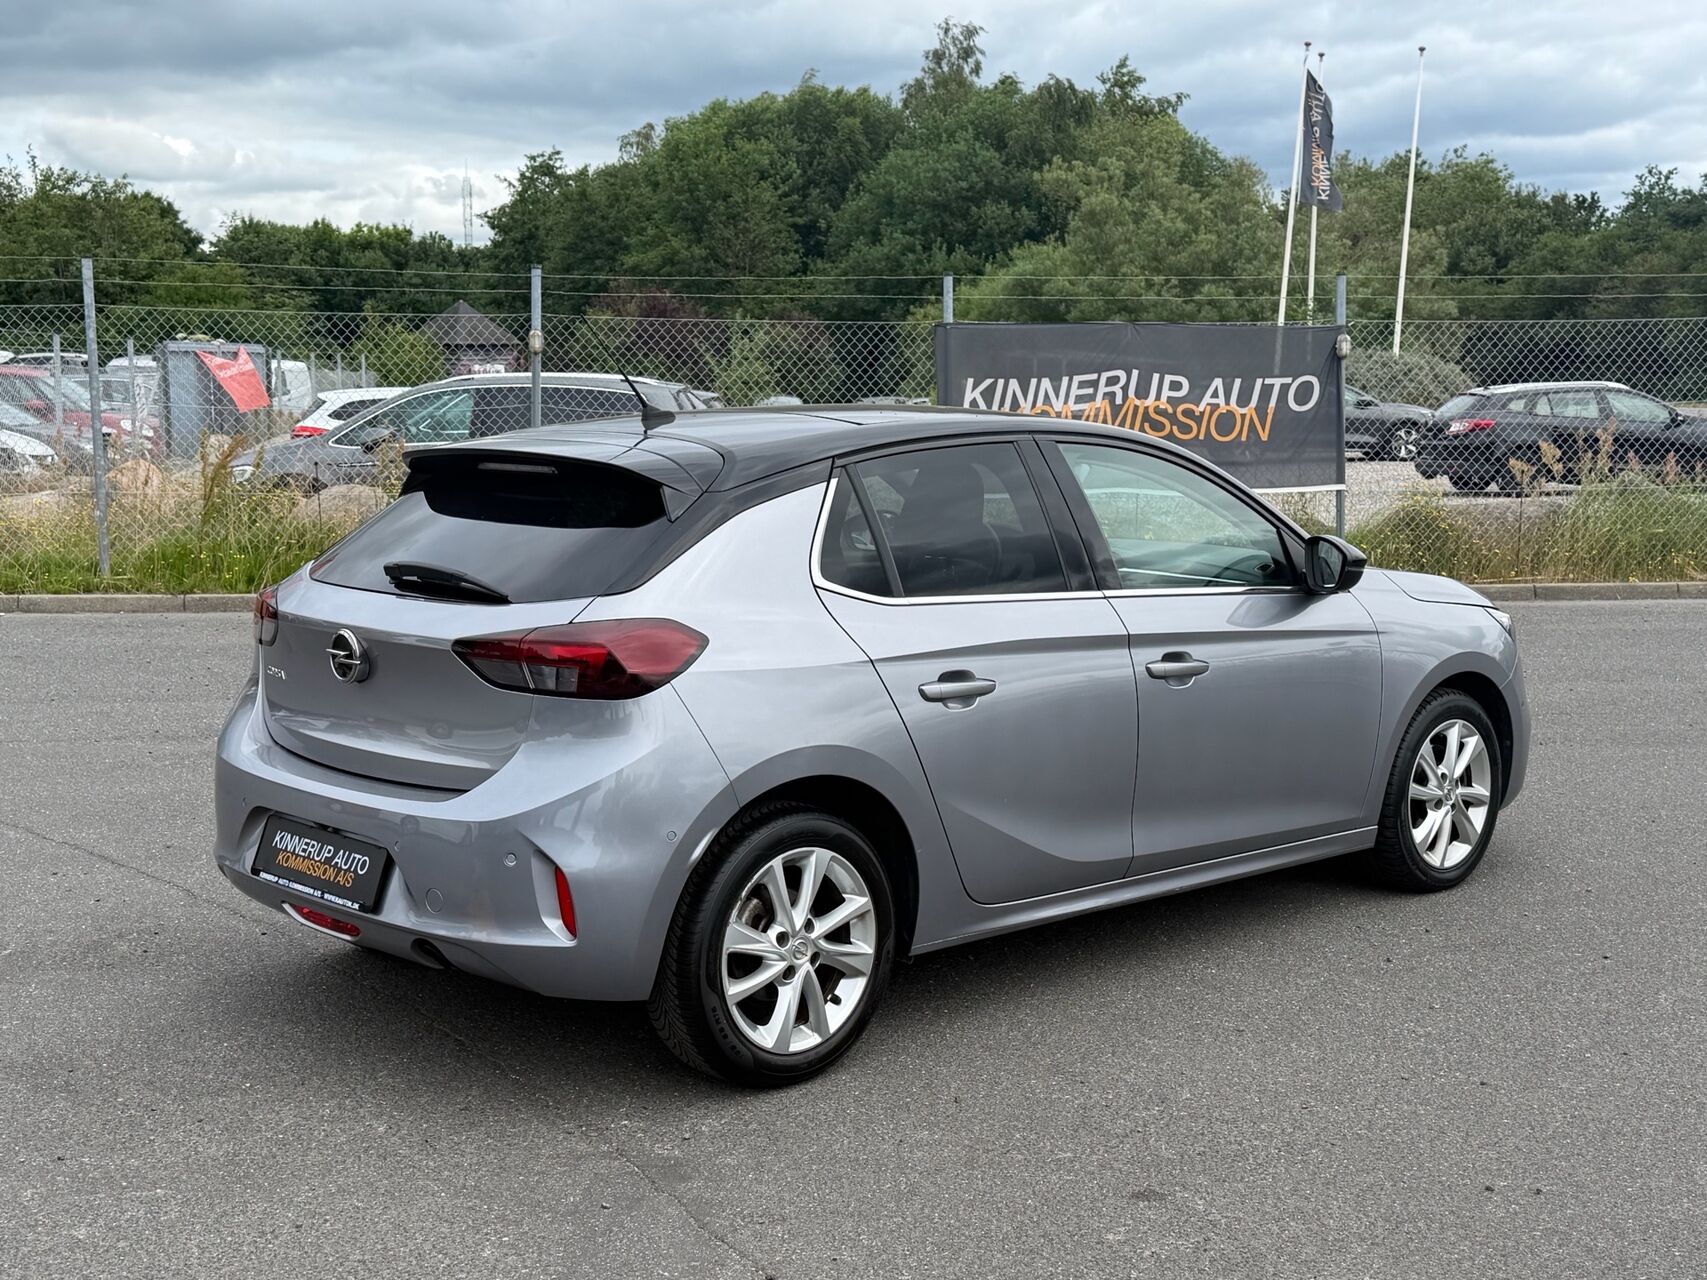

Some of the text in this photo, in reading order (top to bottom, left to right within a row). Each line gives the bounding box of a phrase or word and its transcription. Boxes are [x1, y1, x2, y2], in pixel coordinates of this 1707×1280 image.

[963, 369, 1321, 414] KINNERUP AUTO
[272, 830, 370, 875] KINNERUP AUTO
[275, 850, 355, 888] KOMMISSION A/S
